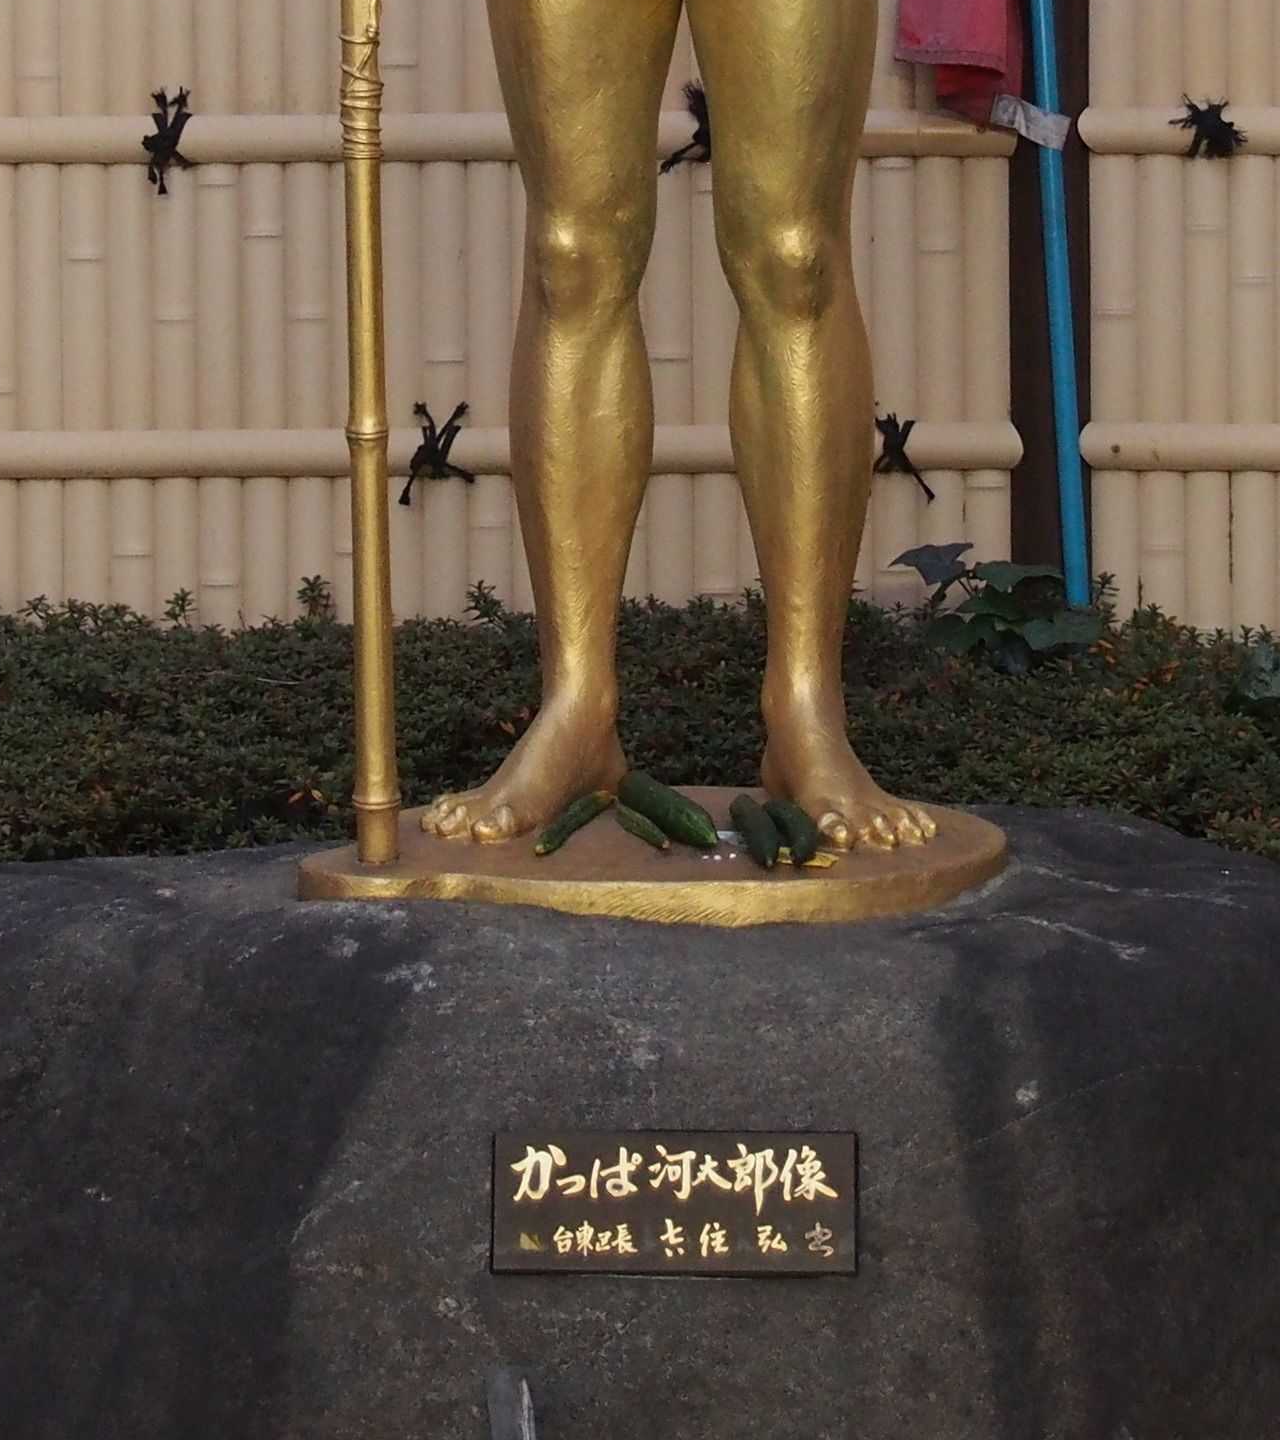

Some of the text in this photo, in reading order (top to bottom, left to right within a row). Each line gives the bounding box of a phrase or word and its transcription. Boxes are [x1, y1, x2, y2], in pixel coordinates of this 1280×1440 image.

[510, 1143, 838, 1216] かっぱ河太郎像
